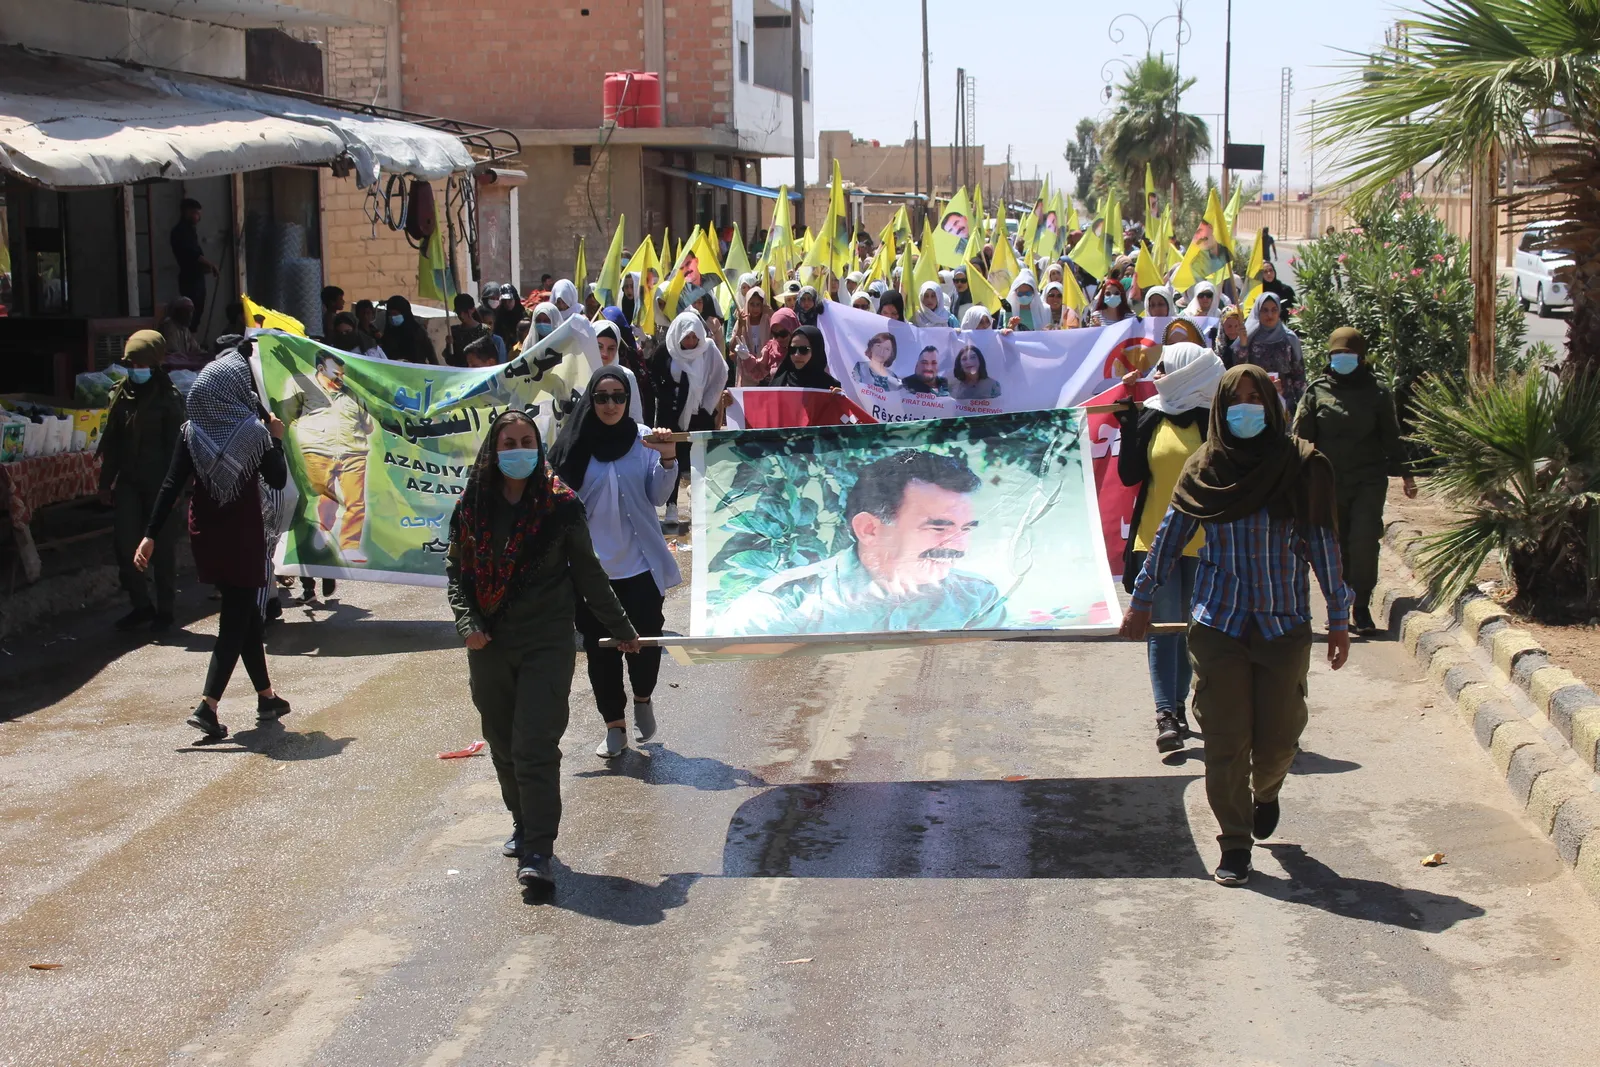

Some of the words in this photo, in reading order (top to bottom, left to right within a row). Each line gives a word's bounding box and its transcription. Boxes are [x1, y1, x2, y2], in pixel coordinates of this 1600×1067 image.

[503, 347, 563, 382] حرية
[393, 377, 432, 416] آبو
[901, 397, 920, 405] FIRAT
